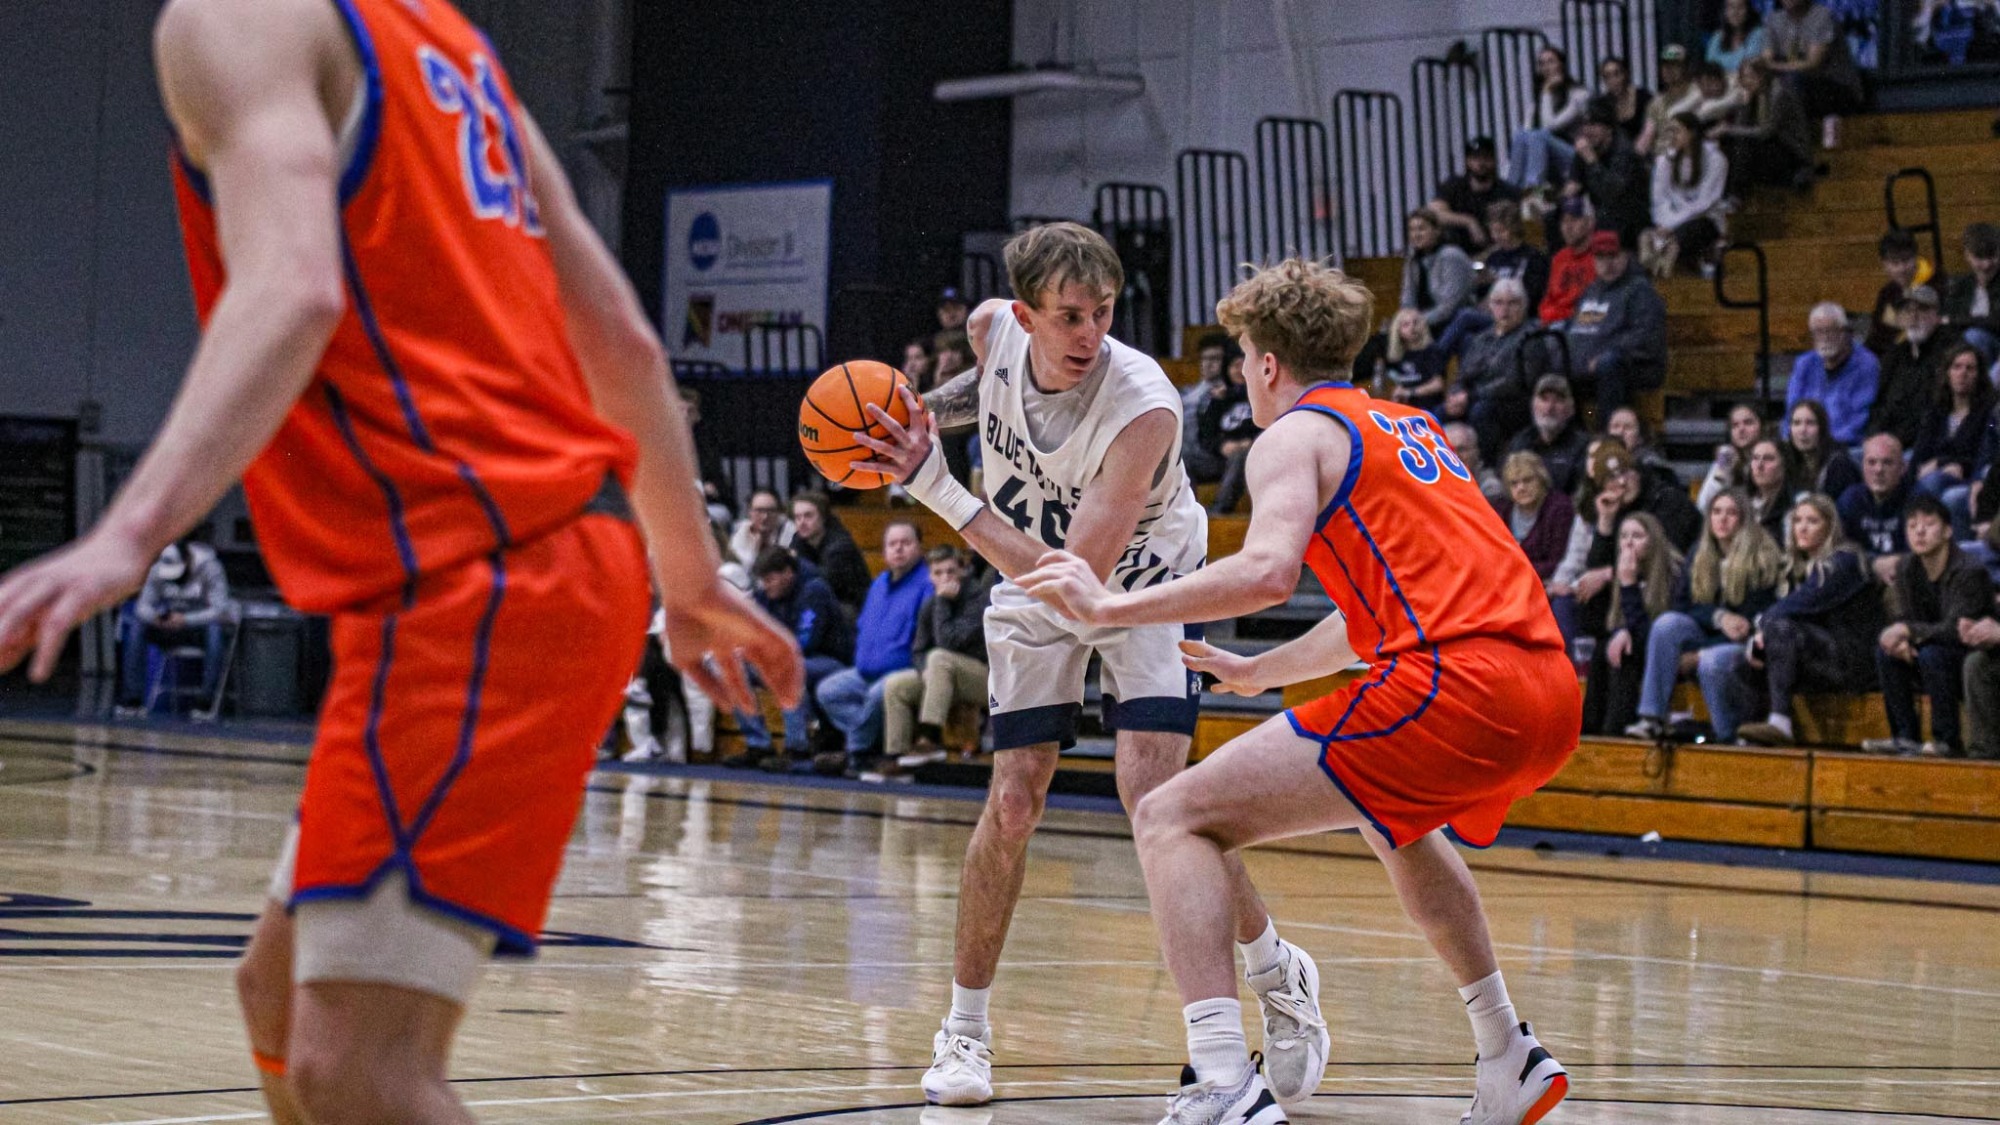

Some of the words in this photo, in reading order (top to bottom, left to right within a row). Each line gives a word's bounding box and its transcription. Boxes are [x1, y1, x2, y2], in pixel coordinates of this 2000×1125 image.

[986, 411, 1025, 471] BLUE
[1367, 410, 1471, 484] 33
[992, 474, 1073, 550] 40
